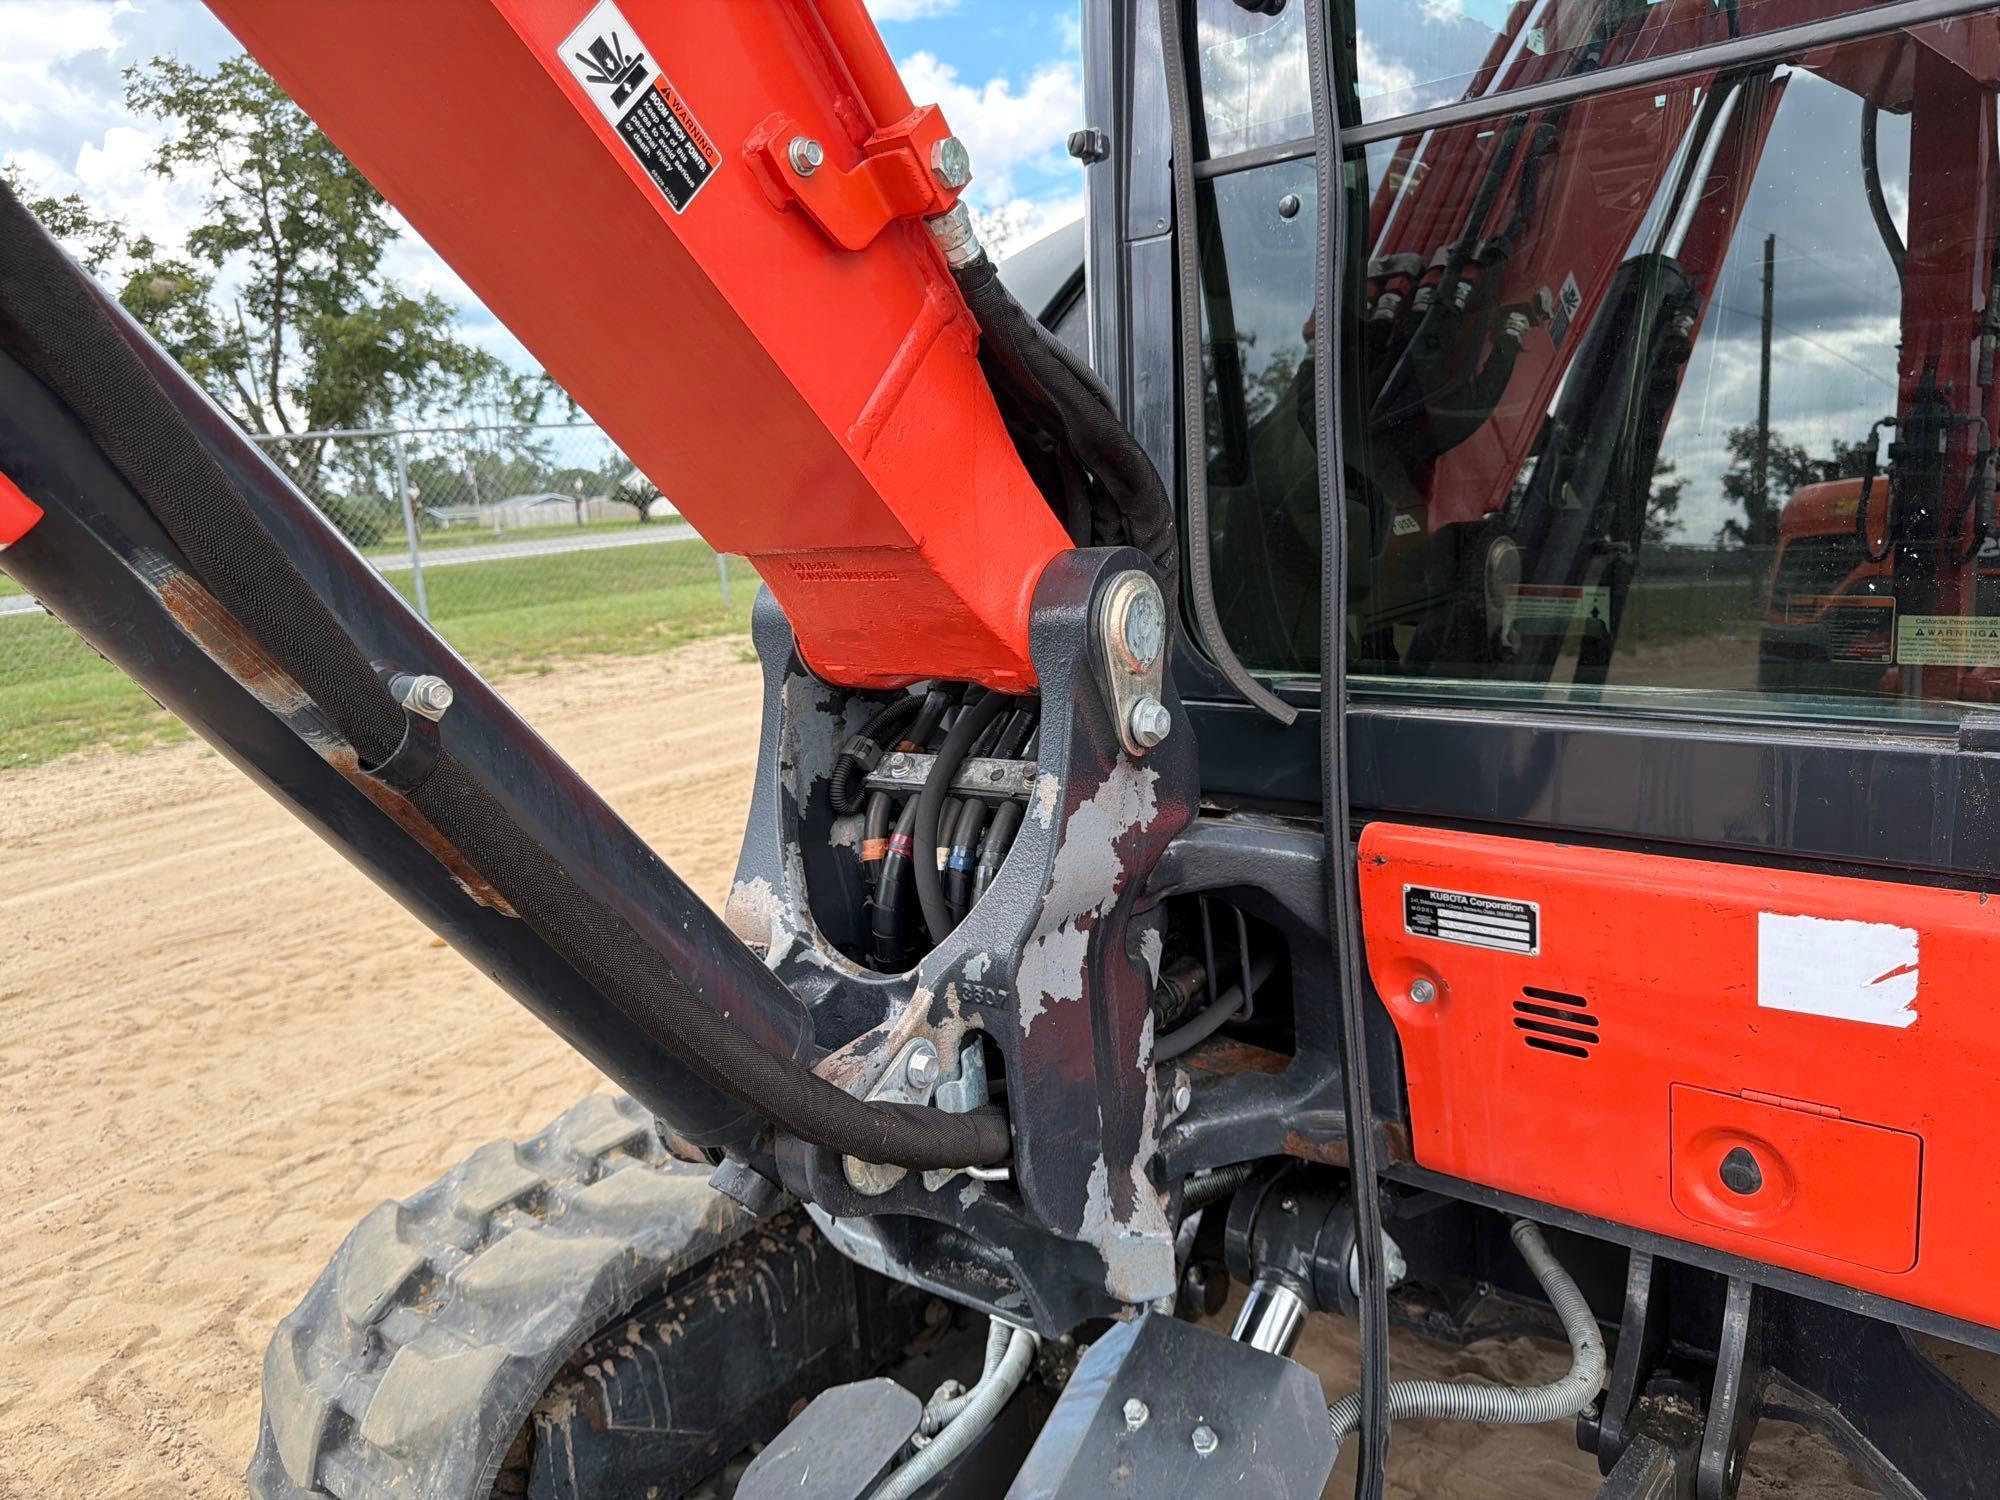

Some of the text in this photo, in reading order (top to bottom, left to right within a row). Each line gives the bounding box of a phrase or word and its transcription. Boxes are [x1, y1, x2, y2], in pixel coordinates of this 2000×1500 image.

[625, 122, 651, 158] or death.
[630, 115, 673, 172] personal injury
[637, 109, 696, 188] area to avoid serious
[642, 100, 688, 163] Keep out of this
[649, 91, 707, 173] BOOM PINCH POINTS:
[672, 99, 714, 158] WARNING
[1915, 616, 1947, 625] California
[1948, 618, 1988, 626] Proposition
[1927, 628, 1987, 638] WARNING
[1411, 905, 1434, 914] MODEL
[1429, 891, 1469, 905] KUBOTA
[1469, 897, 1524, 913] Corporation
